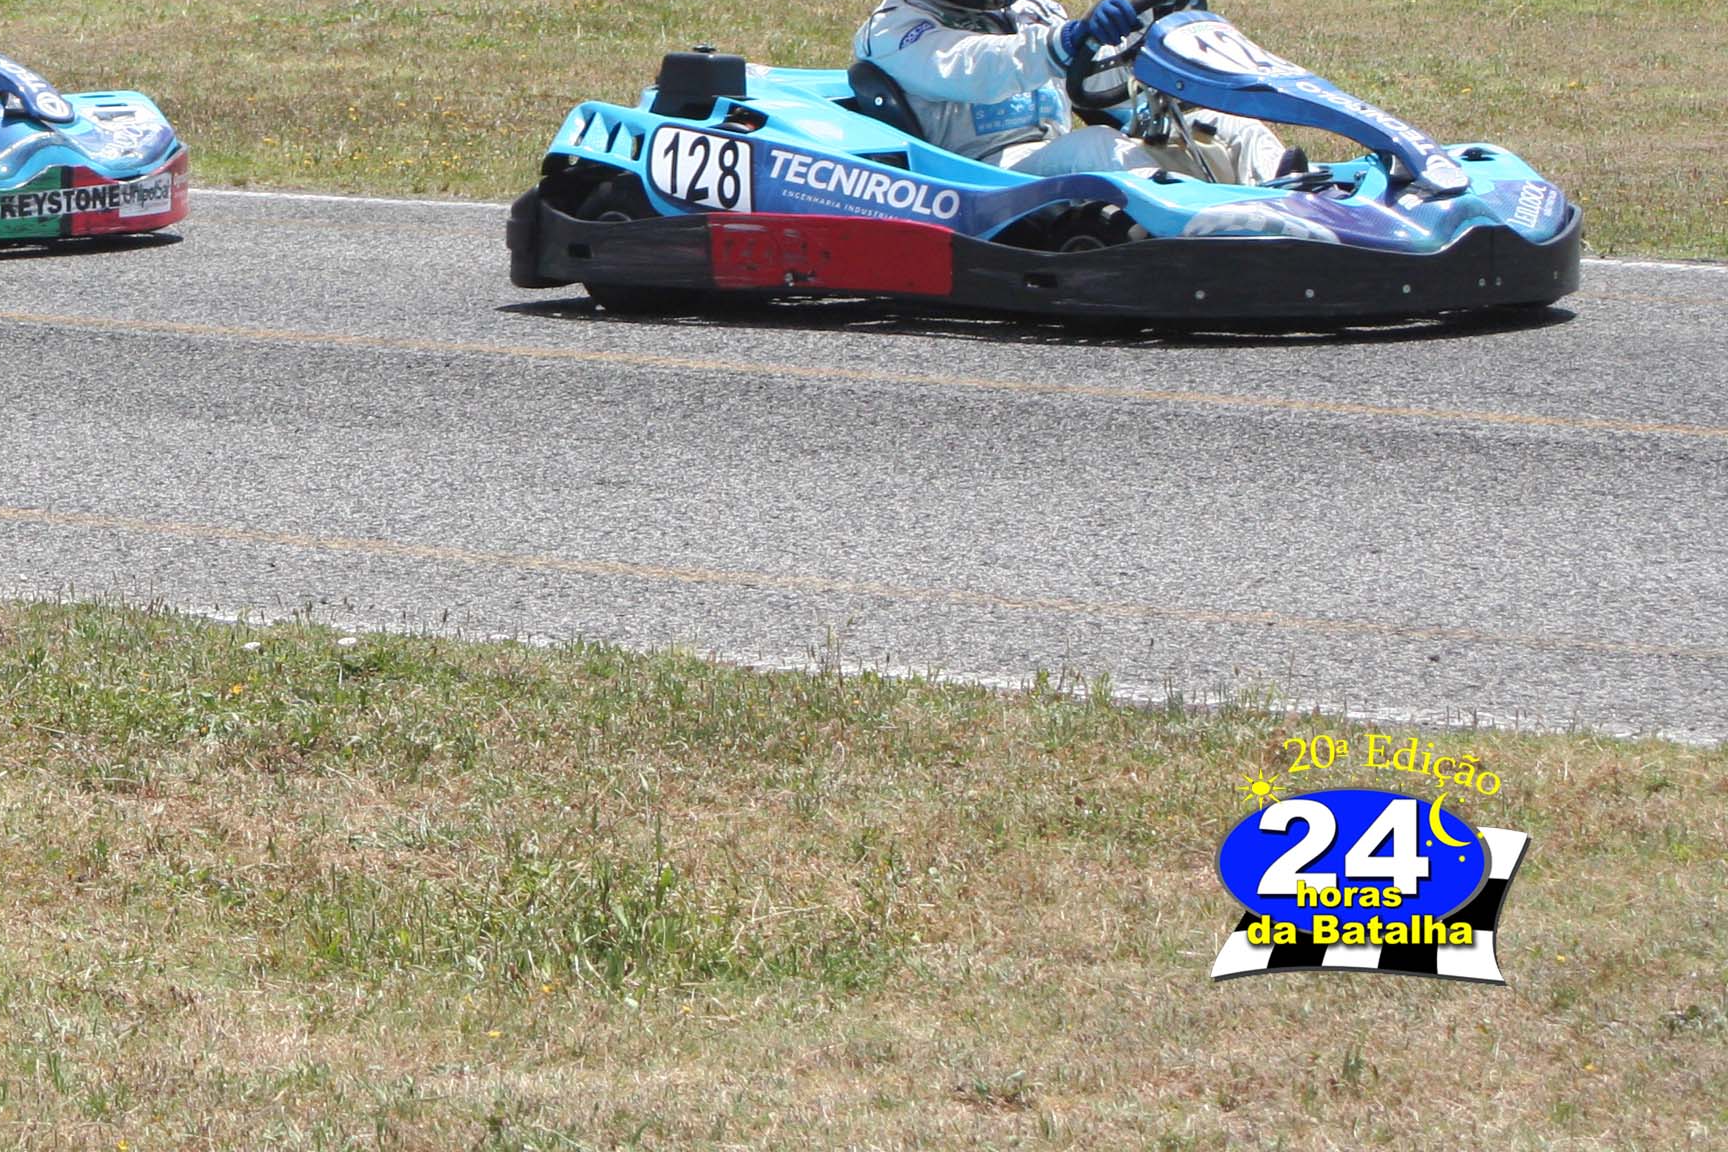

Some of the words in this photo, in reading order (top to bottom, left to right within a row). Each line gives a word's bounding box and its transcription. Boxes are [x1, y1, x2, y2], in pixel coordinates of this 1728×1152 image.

[662, 126, 741, 209] 128
[769, 149, 961, 220] TECNIROLO
[0, 184, 120, 219] KEYSTONE
[781, 189, 841, 210] ENGENHARIA
